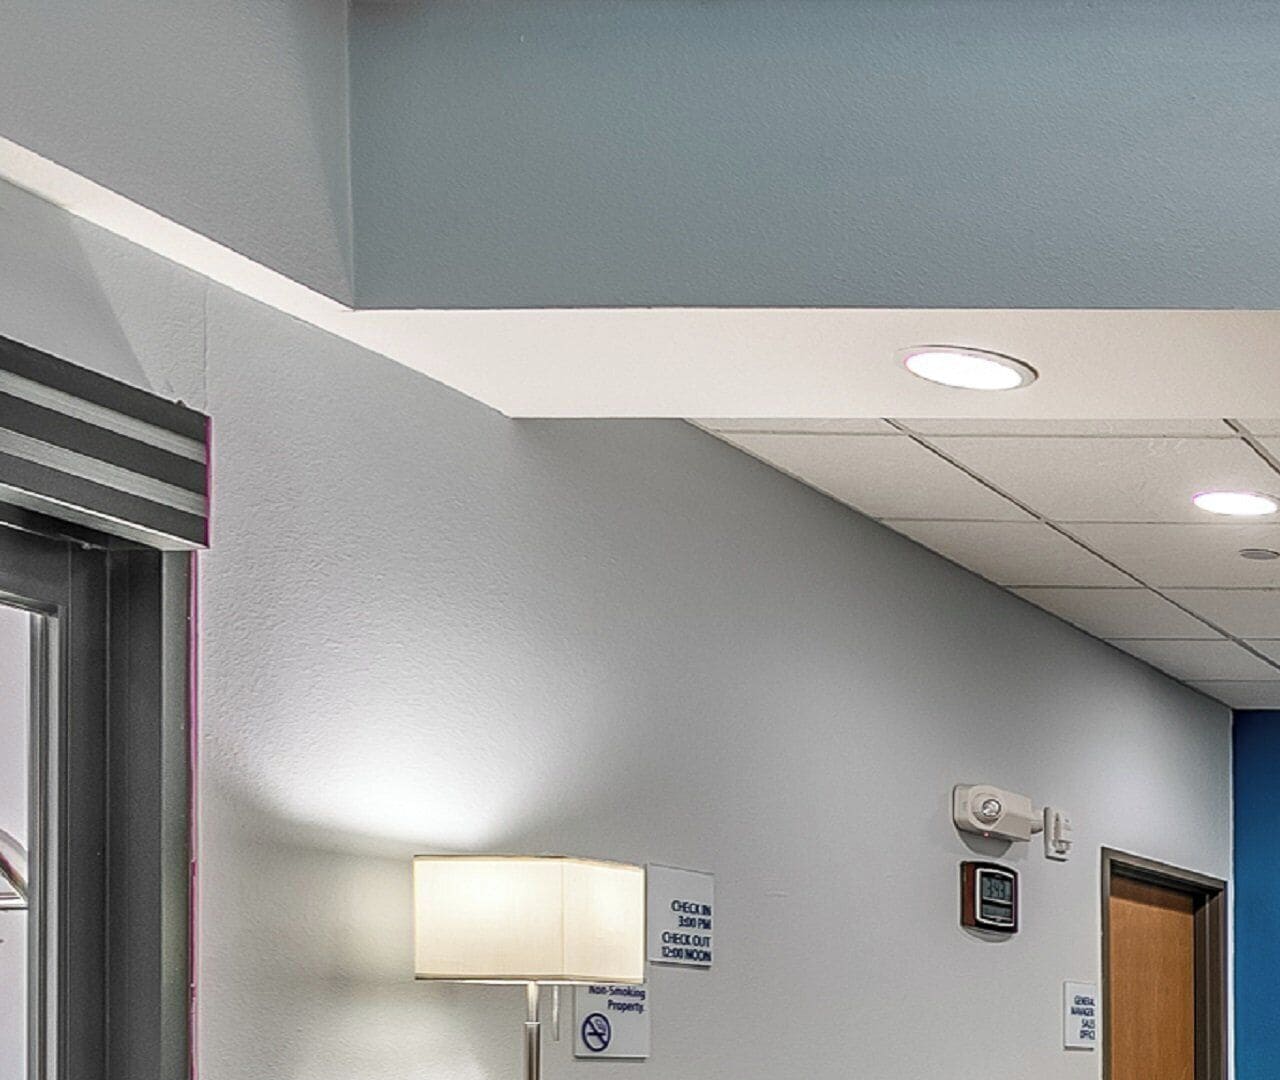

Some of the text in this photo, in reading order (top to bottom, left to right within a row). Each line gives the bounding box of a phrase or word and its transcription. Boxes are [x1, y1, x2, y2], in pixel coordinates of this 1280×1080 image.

[671, 899, 712, 916] CHECK IN
[678, 915, 712, 930] 3:00 PM
[661, 931, 712, 948] CHECK OUT
[662, 945, 712, 961] 12:00 NOON
